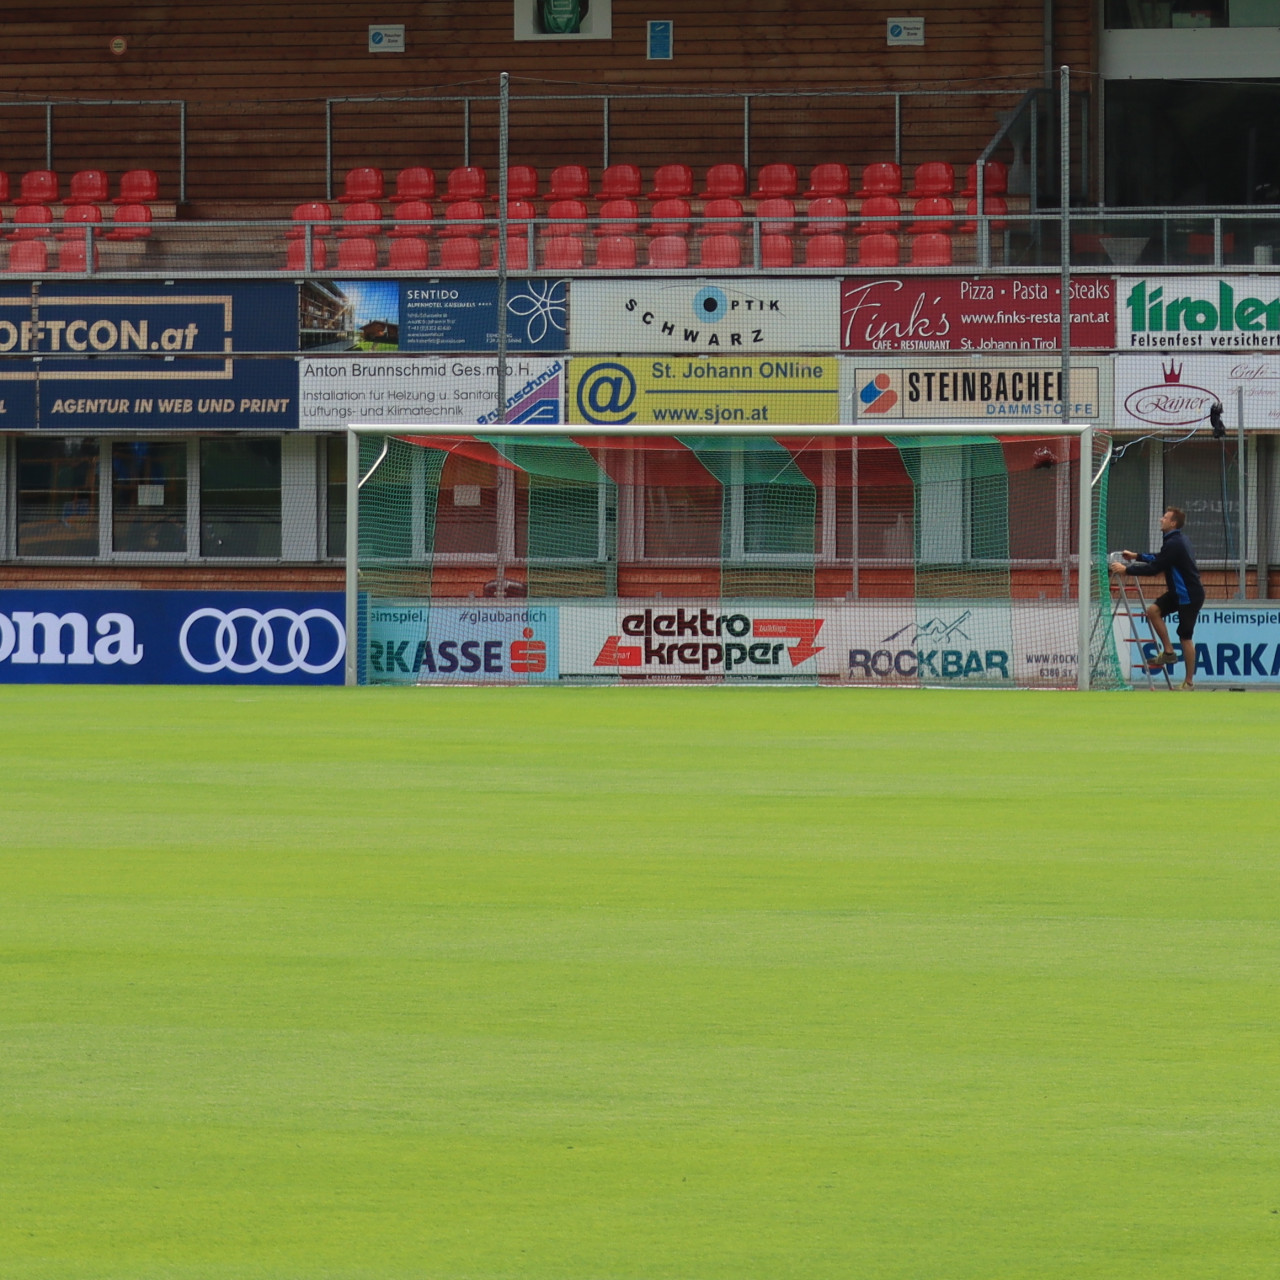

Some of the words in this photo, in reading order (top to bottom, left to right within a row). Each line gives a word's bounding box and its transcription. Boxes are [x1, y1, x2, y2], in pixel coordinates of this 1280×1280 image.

[407, 290, 459, 300] SENTIDO
[961, 281, 994, 300] Pizza
[1013, 281, 1048, 300] Pasta
[1068, 280, 1110, 299] Steaks
[625, 298, 764, 347] SCHWARZ
[961, 311, 1109, 325] www.finks-restarant.at
[900, 340, 950, 350] RESTAURANT
[961, 337, 974, 350] St.
[977, 337, 1018, 350] Johann
[1020, 337, 1031, 350] in
[1032, 337, 1057, 350] Tirol
[1131, 334, 1203, 347] Felsenfest
[304, 363, 347, 377] Anton
[351, 362, 446, 377] Brunnschmid
[451, 362, 535, 377] Ges.mb.H.
[652, 362, 676, 379] St.
[683, 362, 753, 379] Johann
[759, 362, 824, 379] ONline
[477, 361, 563, 425] Brunschmid
[909, 371, 1063, 402] STEINBACHE
[303, 390, 366, 402] Installation
[369, 390, 384, 402] für
[387, 390, 436, 404] Heizung
[51, 398, 130, 414] AGENTUR
[134, 398, 152, 414] IN
[153, 398, 195, 414] WEB
[197, 398, 236, 414] UND
[239, 398, 290, 414] PRINT
[303, 405, 357, 419] Lüftungs-
[360, 405, 384, 417] und
[387, 405, 464, 417] Klimatechnik
[986, 402, 1093, 415] DÄMMSTOFE
[653, 405, 768, 424] www.sjon.at
[370, 610, 427, 624] eimspiel.
[459, 610, 547, 625] #glaubandich
[622, 608, 751, 637] elektro
[370, 640, 503, 673] RKASSE
[644, 636, 785, 670] krepper
[849, 649, 1009, 679] ROCKBAR
